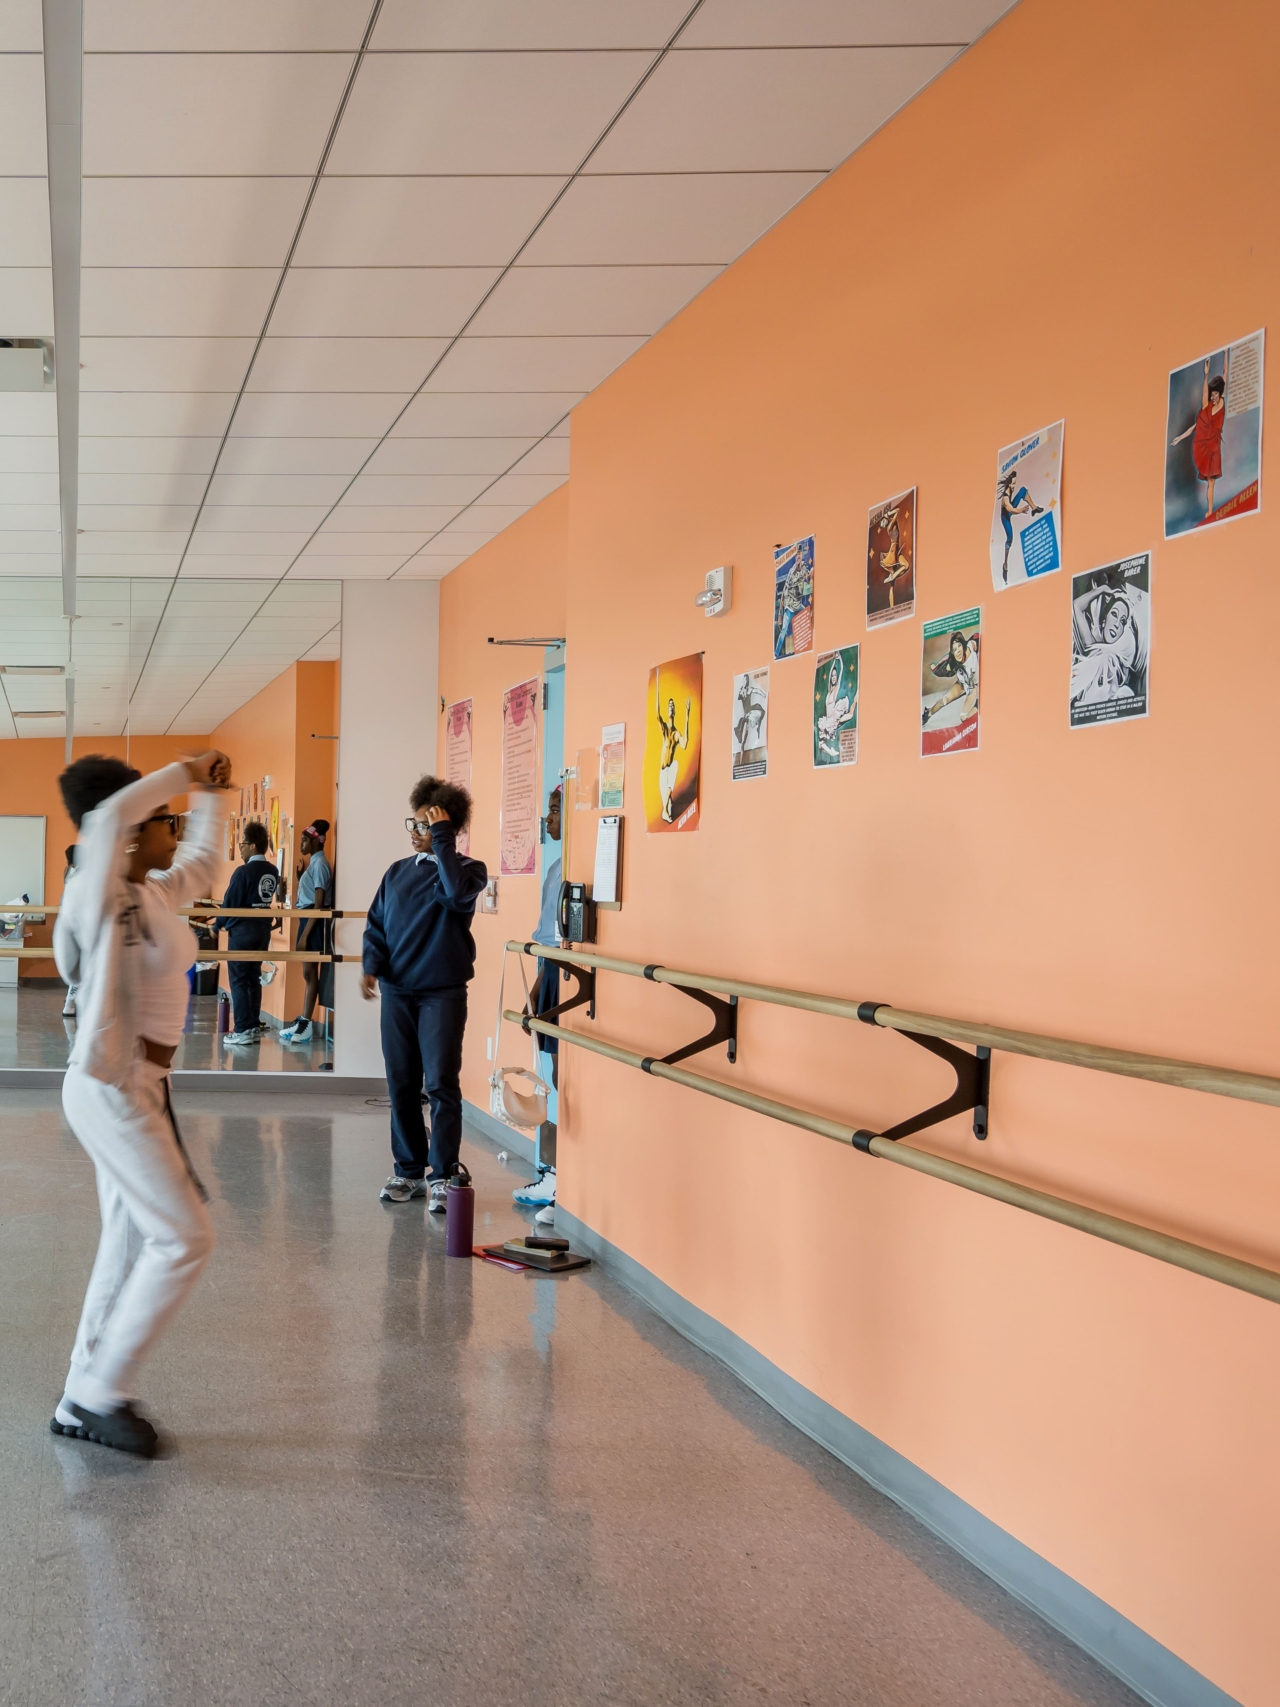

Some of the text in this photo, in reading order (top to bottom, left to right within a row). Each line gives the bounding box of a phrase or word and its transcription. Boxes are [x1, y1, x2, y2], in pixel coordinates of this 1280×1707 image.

[1020, 436, 1040, 458] GLOVER
[1216, 483, 1257, 520] DEBBIE ALLEN
[1118, 556, 1147, 572] JOSEPHINE
[1124, 566, 1141, 577] BAKER
